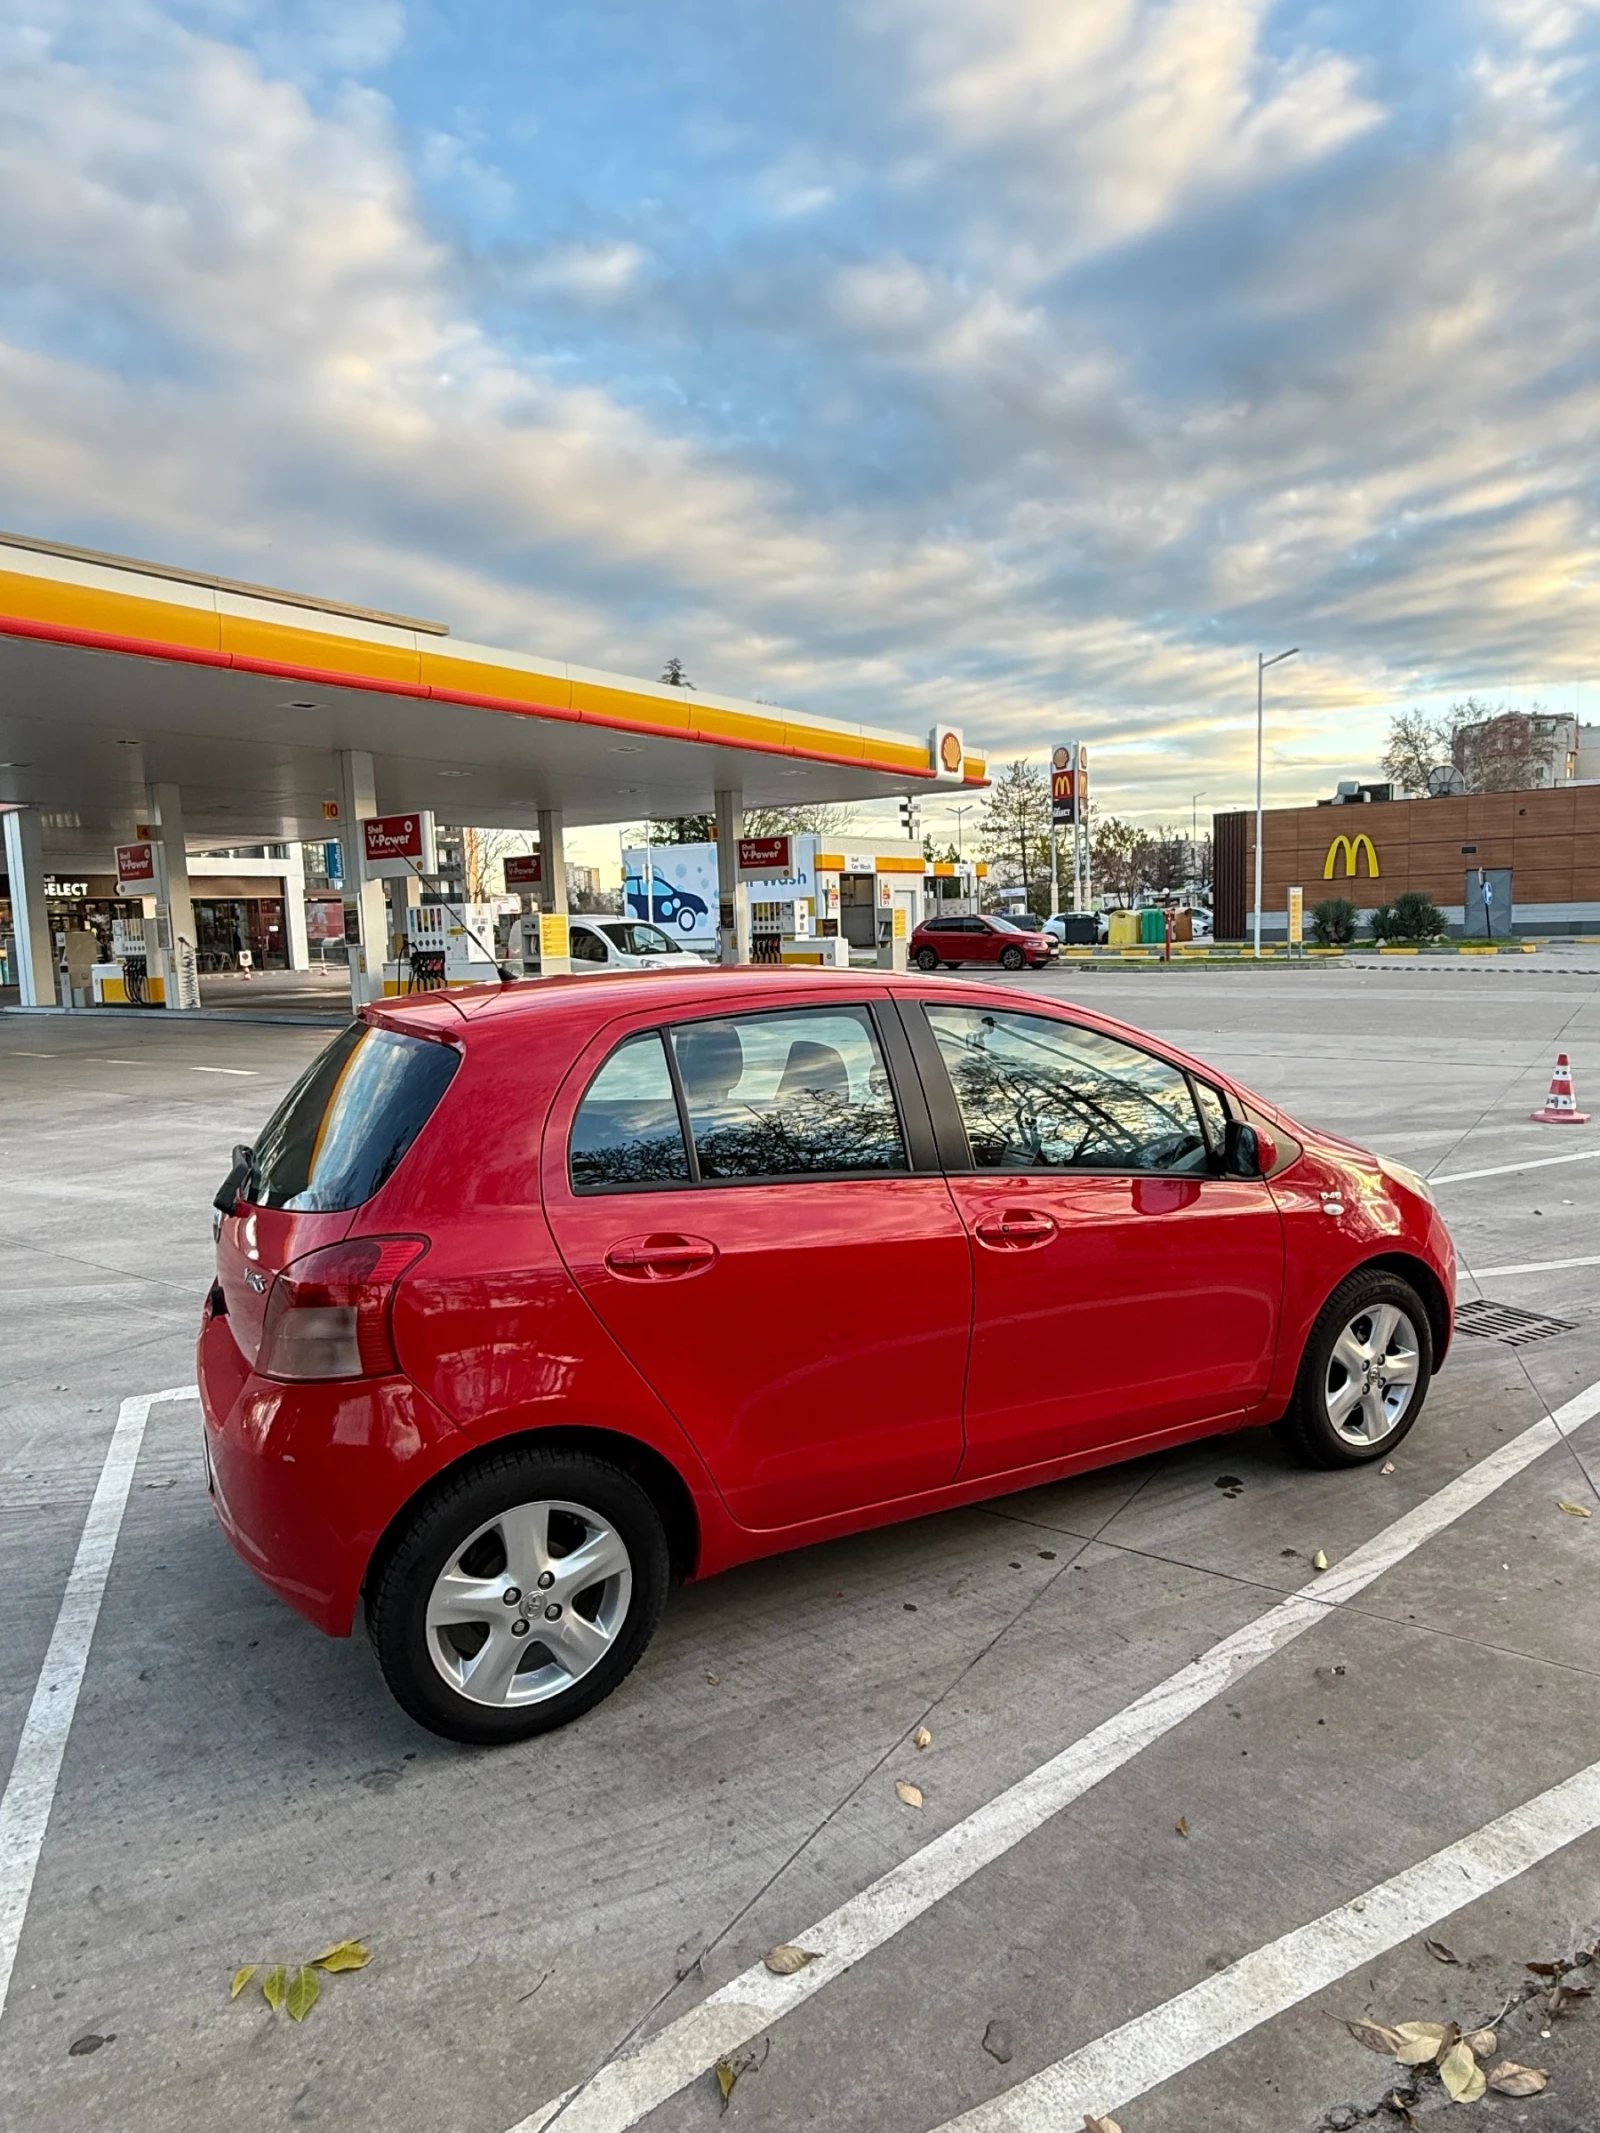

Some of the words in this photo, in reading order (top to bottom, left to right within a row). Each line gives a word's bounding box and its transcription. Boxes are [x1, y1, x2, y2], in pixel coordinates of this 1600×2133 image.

[367, 824, 383, 834] Shell
[368, 835, 410, 847] V-Power
[742, 850, 779, 860] V-Power
